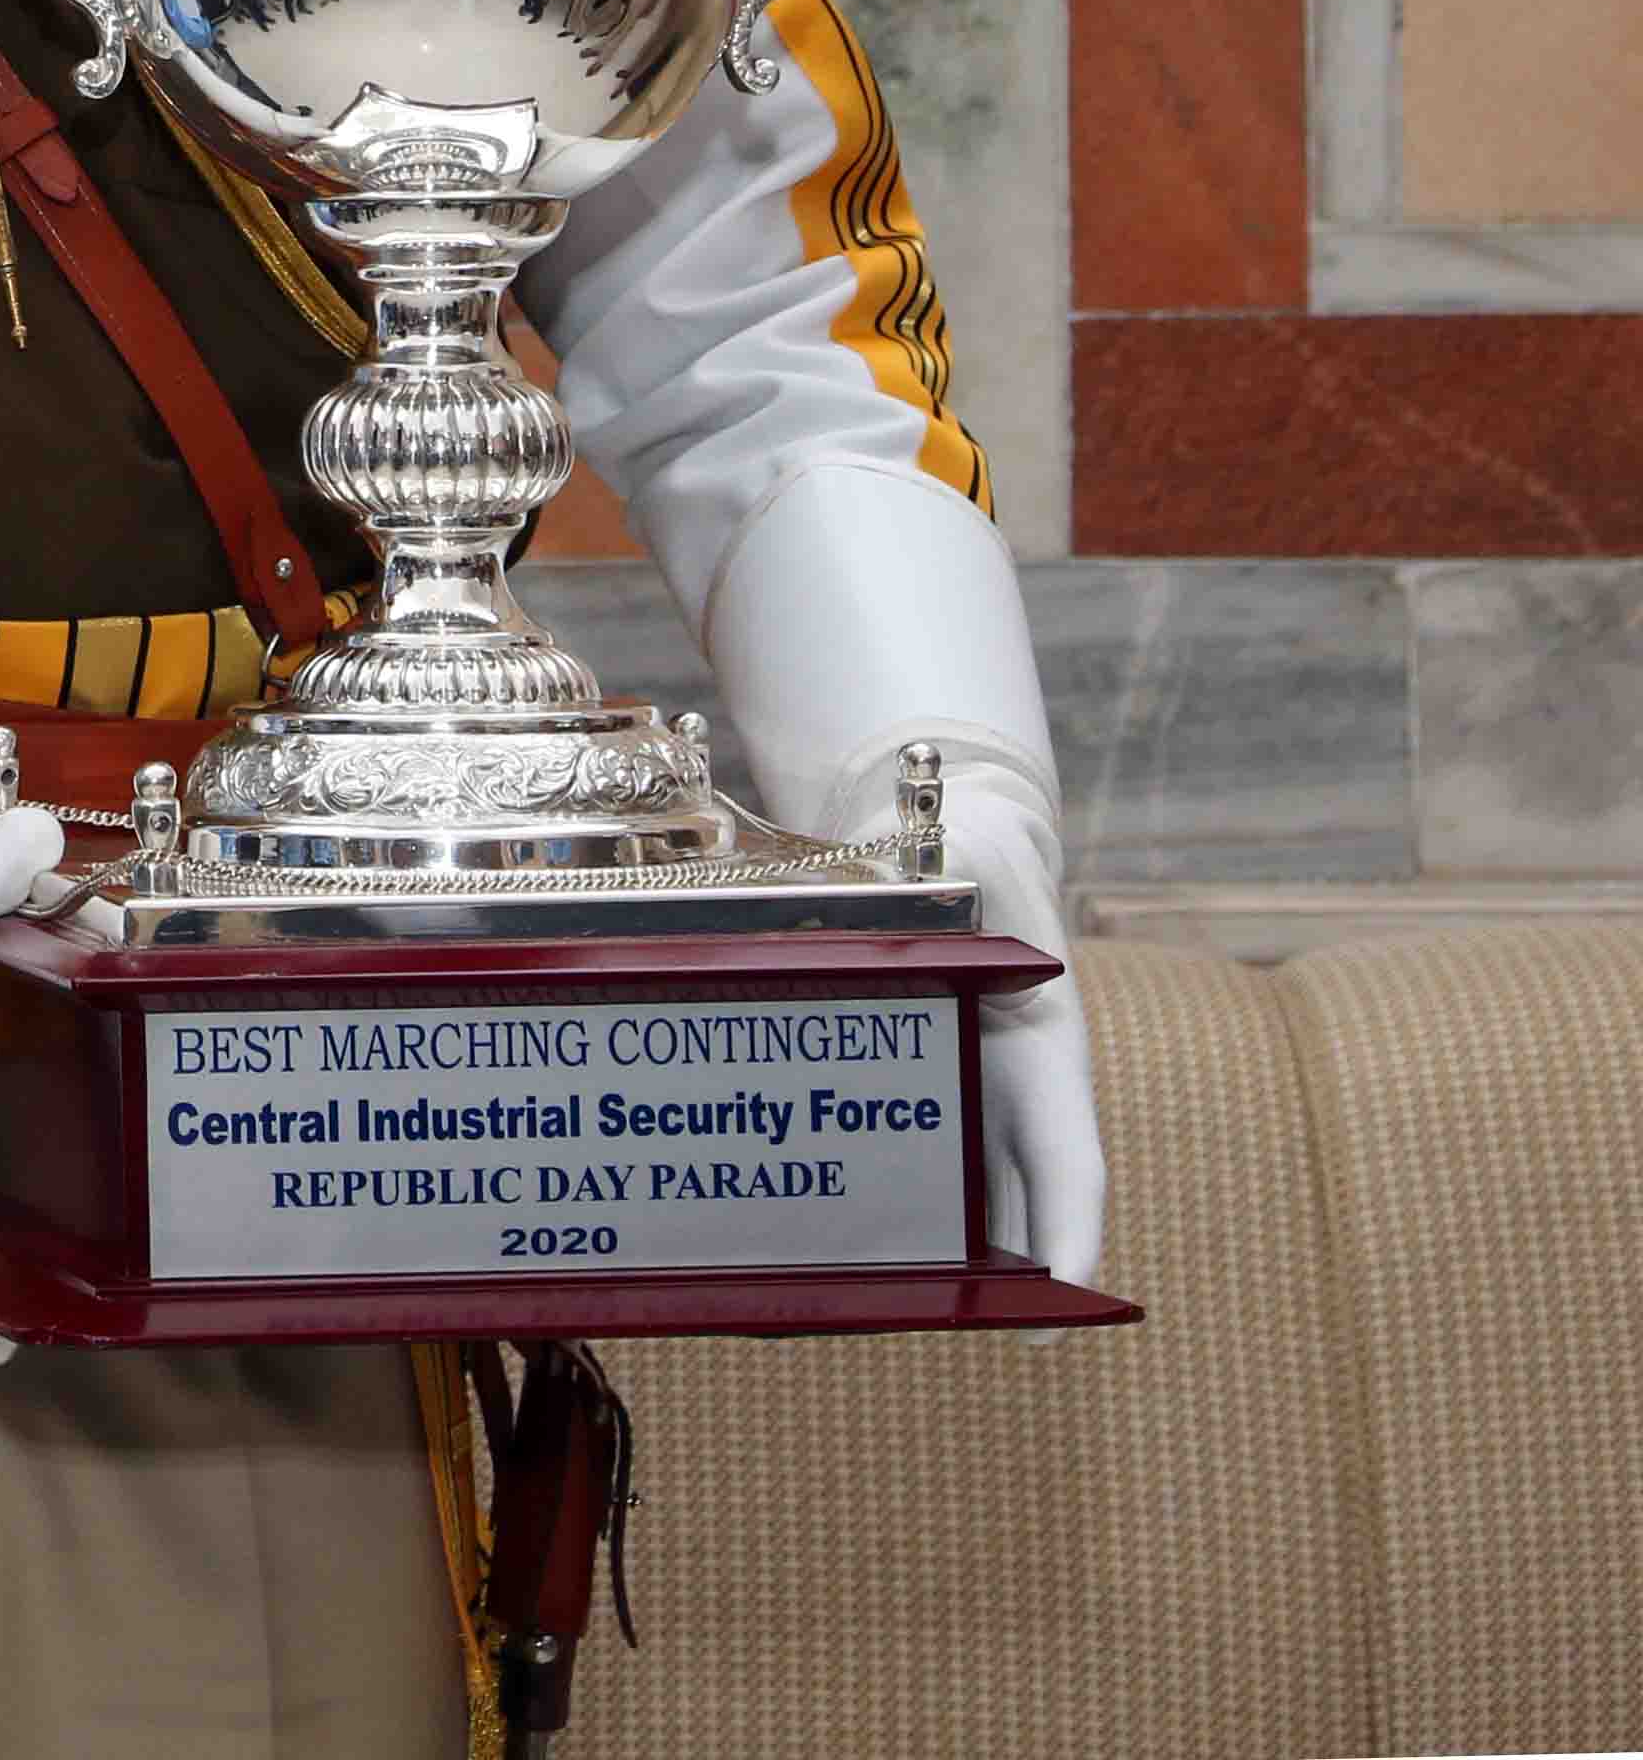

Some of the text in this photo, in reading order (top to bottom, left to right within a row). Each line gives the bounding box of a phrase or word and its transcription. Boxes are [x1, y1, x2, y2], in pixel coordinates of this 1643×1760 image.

[171, 1012, 933, 1074] BEST MARCHING CONTINGENT
[167, 1088, 943, 1147] Central Industrial Security Force
[270, 1159, 847, 1209] REPUBLIC DAY PARADE
[499, 1225, 619, 1258] 2020
